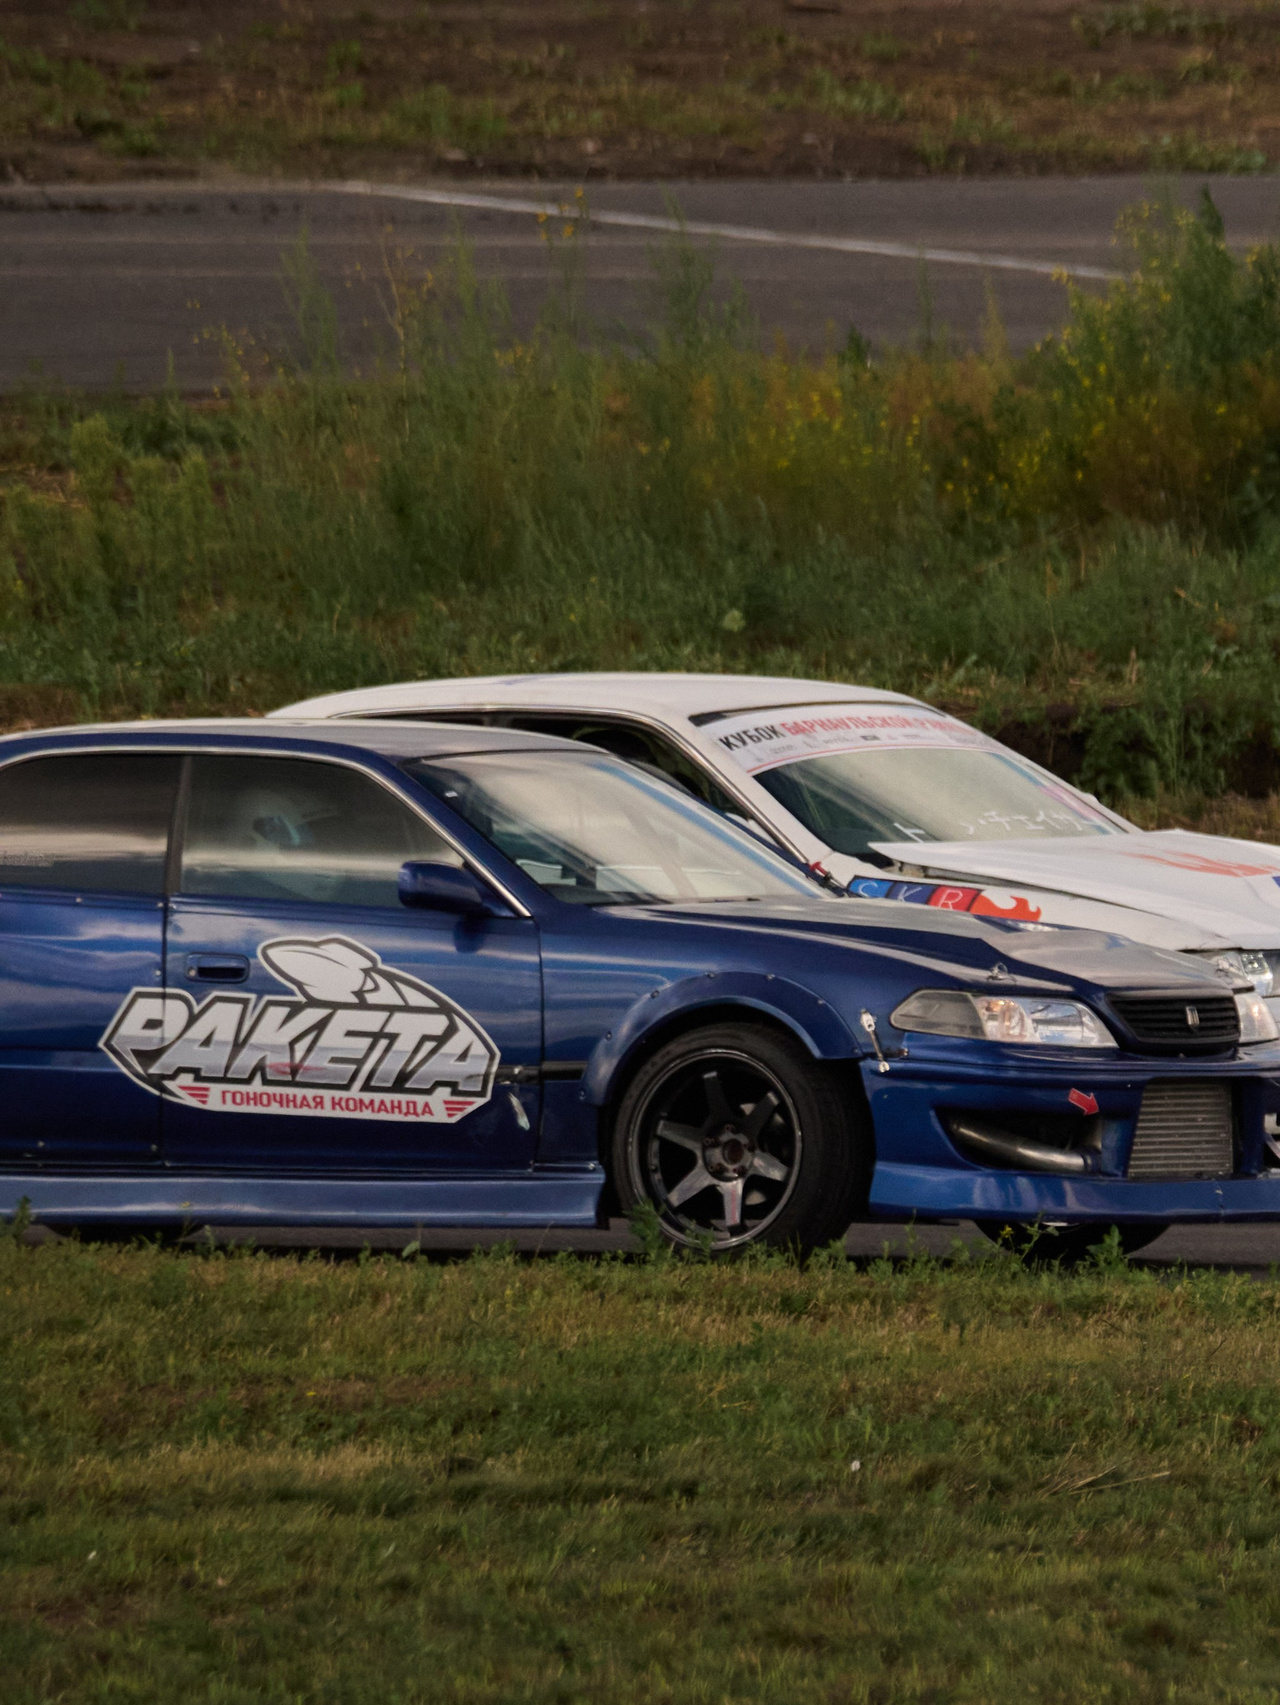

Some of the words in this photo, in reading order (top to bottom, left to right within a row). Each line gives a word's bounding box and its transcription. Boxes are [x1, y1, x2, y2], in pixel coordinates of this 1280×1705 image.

[719, 724, 786, 751] КУБОК
[108, 994, 494, 1093] РАКЕТА
[221, 1089, 325, 1112] ГОНОЧНАЯ
[331, 1095, 435, 1117] КОМАНДА
